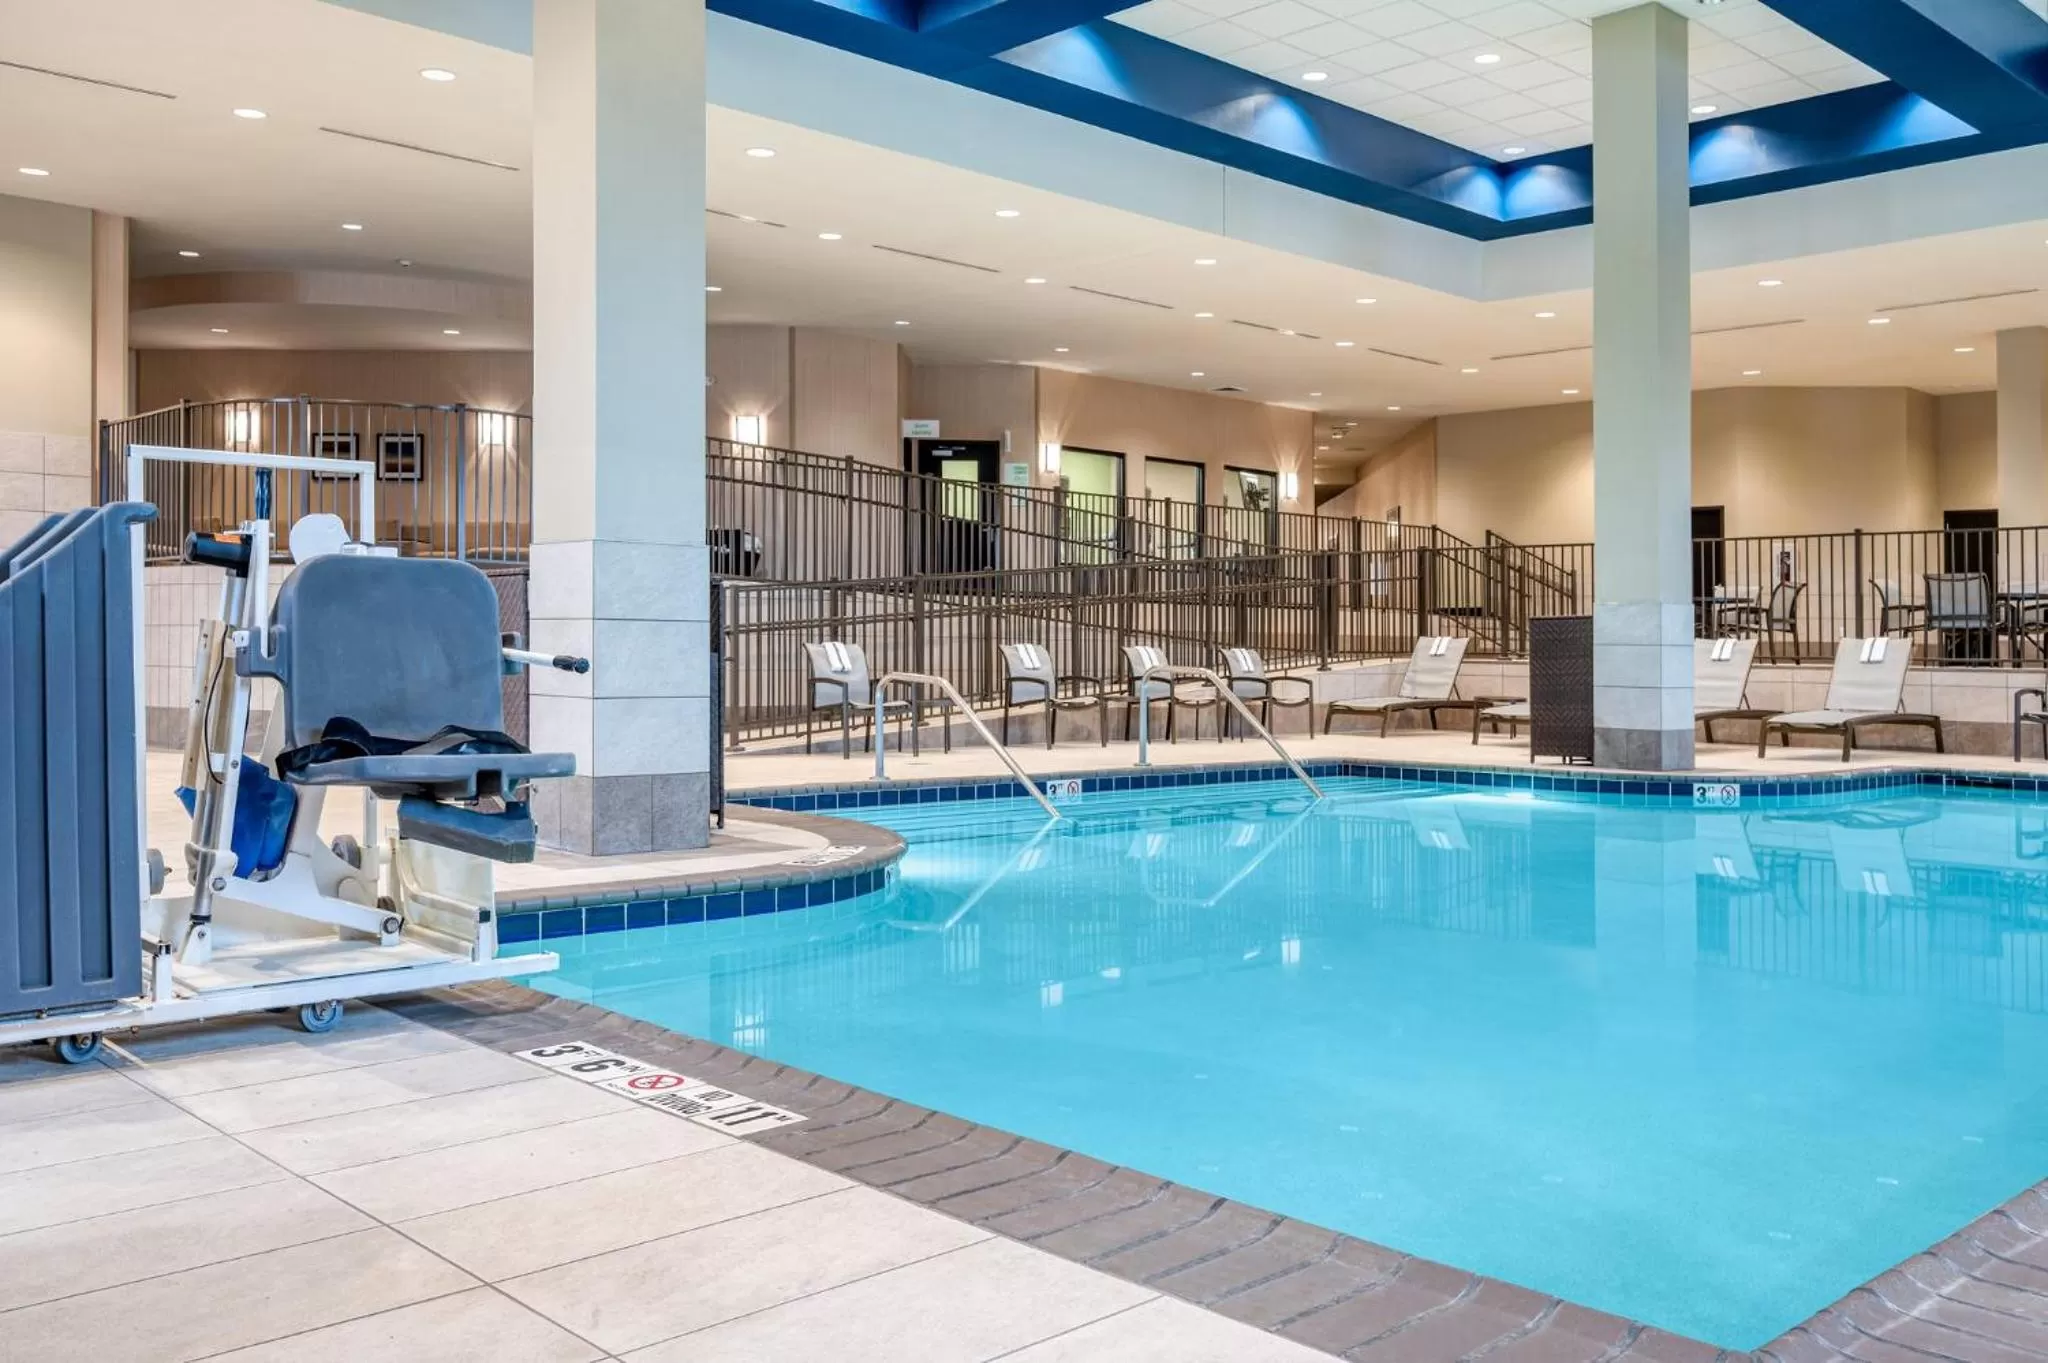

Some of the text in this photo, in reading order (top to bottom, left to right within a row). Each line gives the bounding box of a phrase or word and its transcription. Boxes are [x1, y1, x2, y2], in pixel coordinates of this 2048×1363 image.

[531, 1045, 584, 1057] 3
[571, 1059, 625, 1072] 6
[694, 1090, 734, 1101] NO
